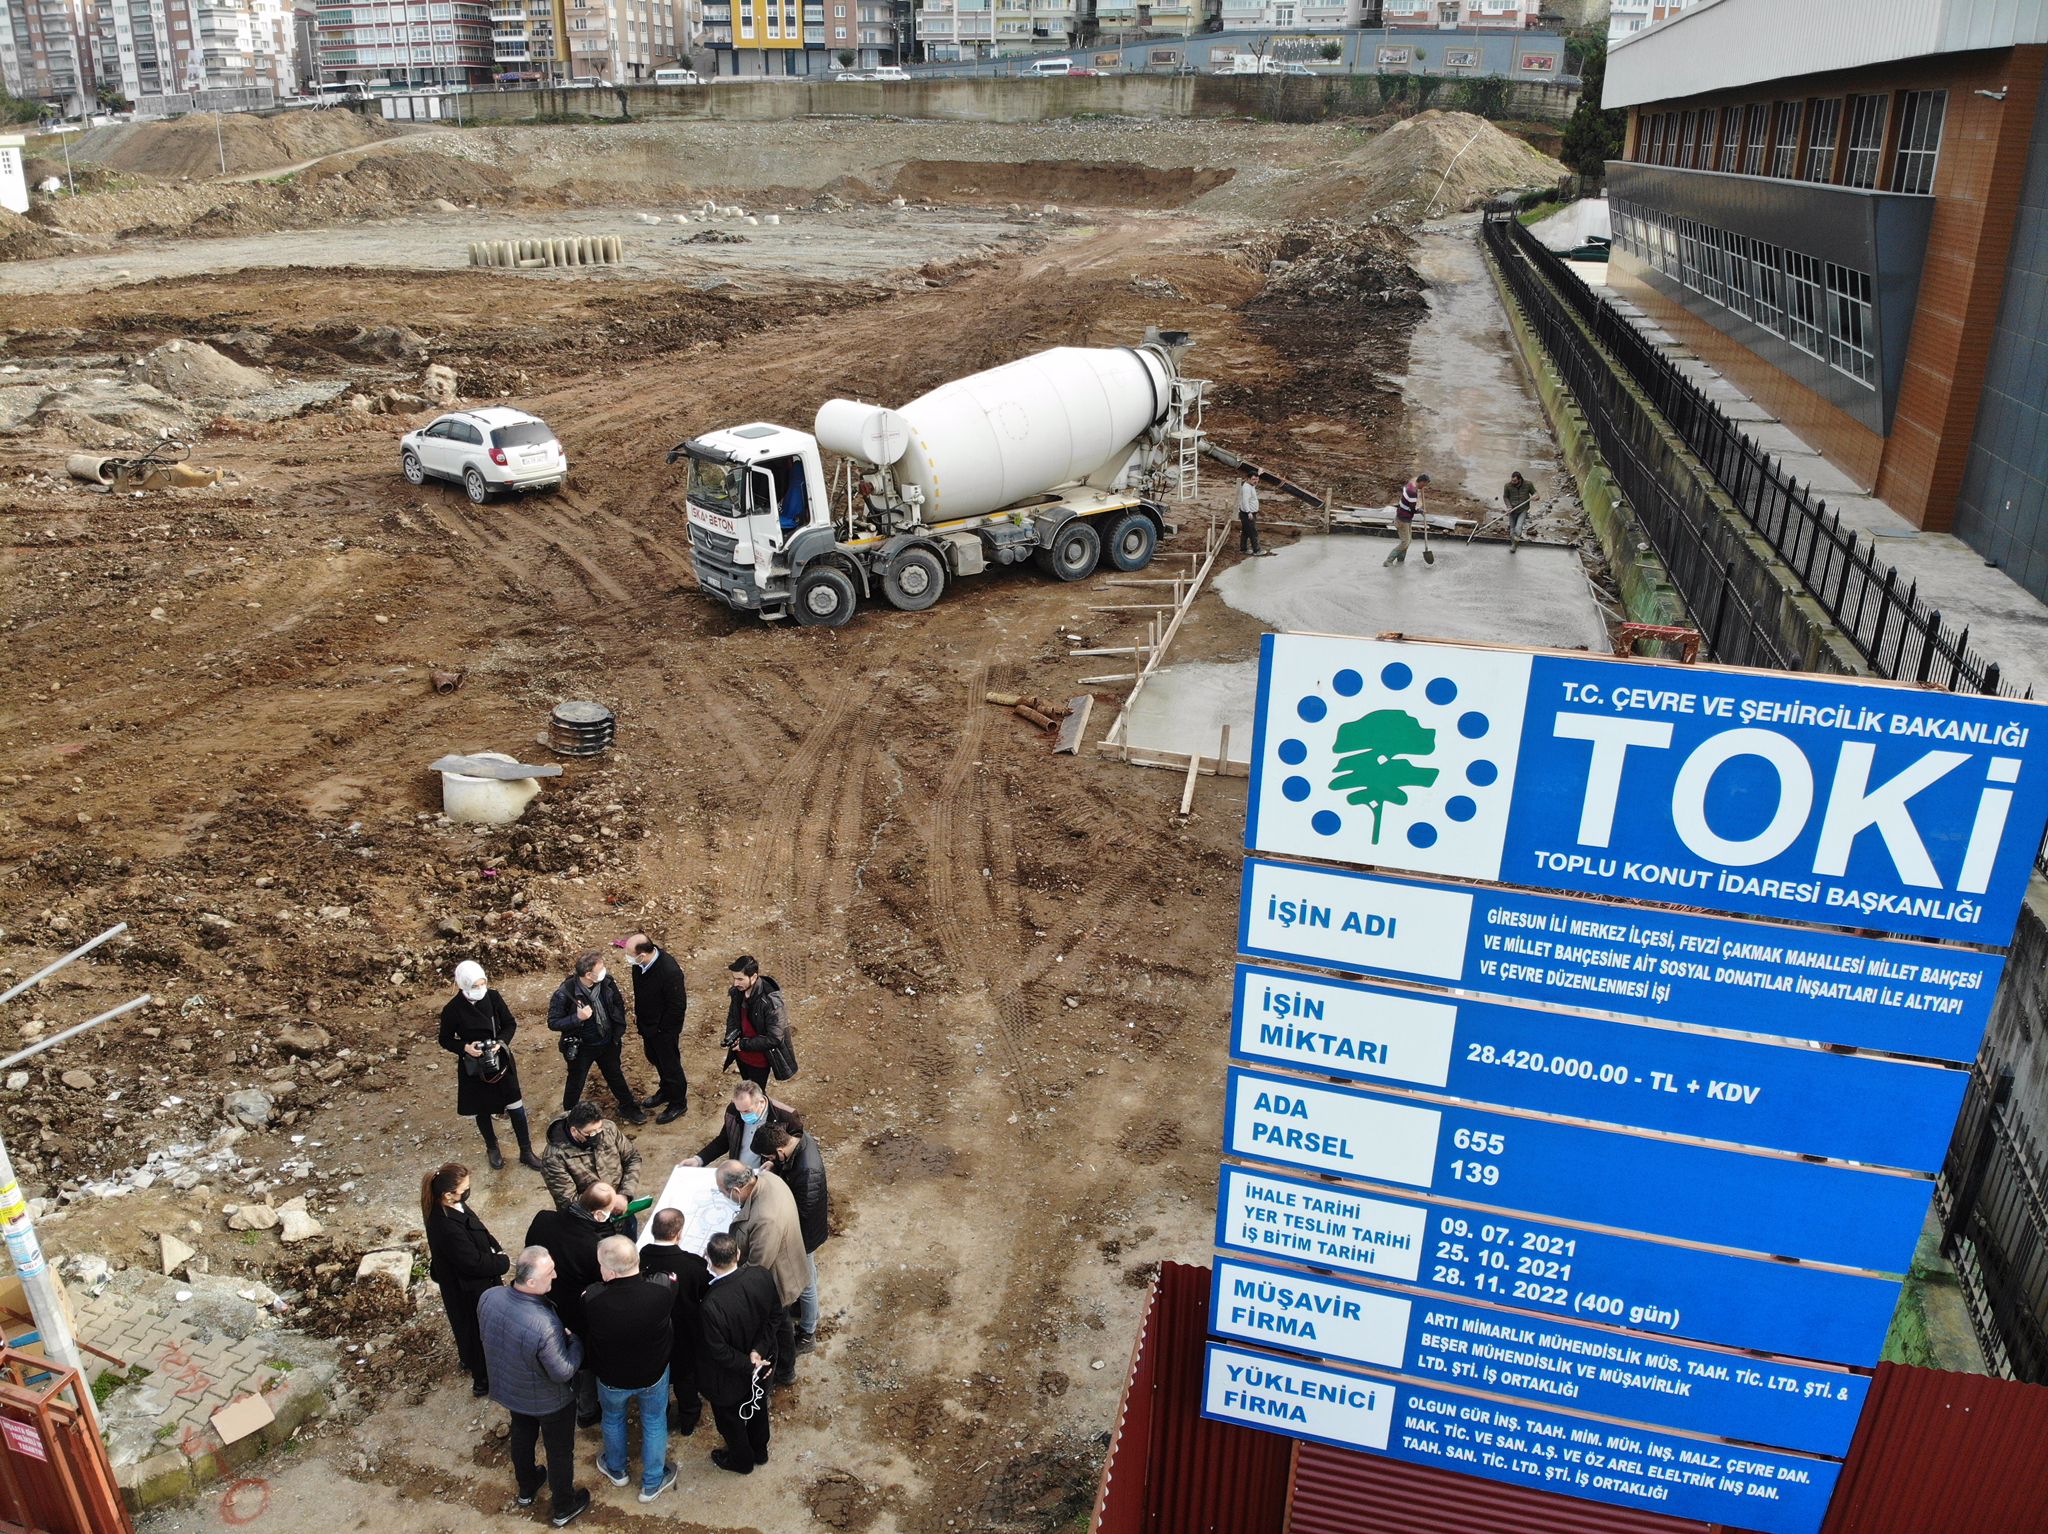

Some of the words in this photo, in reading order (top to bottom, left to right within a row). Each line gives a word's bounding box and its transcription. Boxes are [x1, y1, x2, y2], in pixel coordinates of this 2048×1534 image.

[1562, 682, 1604, 705] T.C.
[1611, 687, 1697, 714] ÇEVRE
[1702, 695, 1735, 718] VE
[1739, 699, 1886, 733] ŞEHİRCİLİK
[1889, 714, 2029, 748] BAKANLIĞI
[1552, 711, 2022, 896] TOKİ
[1534, 850, 1617, 877] TOPLU
[1623, 862, 1714, 889] KONUT
[1718, 869, 1821, 904] İDARESİ
[1825, 887, 1982, 924] BAŞKANLIĞI
[1268, 894, 1332, 929] İŞİN
[1340, 911, 1397, 939] ADI
[1487, 907, 1547, 930] GİRESUN
[1549, 914, 1568, 933] İLİ
[1569, 919, 1627, 942] MERKEZ
[1628, 924, 1676, 952] İLÇESİ,
[1679, 935, 1721, 955] FEVZİ
[1722, 941, 1784, 964] ÇAKMAK
[1784, 949, 1866, 974] MAHALLESİ
[1866, 958, 1919, 981] MİLLET
[1919, 967, 1983, 990] BAHÇESİ
[1480, 959, 1498, 976] VE
[1500, 962, 1544, 984] ÇEVRE
[1546, 969, 1650, 998] DÜZENLENMESİ
[1651, 981, 1671, 1004] İŞİ
[1484, 934, 1502, 951] VE
[1503, 935, 1553, 958] MİLLET
[1554, 944, 1632, 970] BAHÇESİNE
[1632, 953, 1658, 973] AİT
[1659, 959, 1712, 981] SOSYAL
[1714, 967, 1794, 992] DONATILAR
[1795, 975, 1879, 1004] İNŞAATLARI
[1879, 986, 1904, 1007] İLE
[1904, 993, 1964, 1015] ALTYAPI
[1263, 986, 1325, 1021] İŞİN
[1259, 1023, 1388, 1065] MİKTARI
[1466, 1043, 1628, 1085] 28.420.000.00
[1650, 1071, 1678, 1093] TL
[1687, 1079, 1700, 1093] +
[1707, 1080, 1761, 1105] KDV
[1253, 1092, 1309, 1120] ADA
[1252, 1122, 1354, 1160] PARSEL
[1454, 1128, 1505, 1155] 655
[1451, 1159, 1500, 1186] 139
[1245, 1181, 1297, 1207] İHALE
[1302, 1196, 1361, 1220] TARİHİ
[1242, 1225, 1258, 1244] İŞ
[1263, 1230, 1312, 1252] BİTİM
[1317, 1241, 1376, 1265] TARİHİ
[1244, 1205, 1278, 1225] YER
[1283, 1213, 1347, 1238] TESLİM
[1352, 1226, 1411, 1251] TARİHİ
[1441, 1217, 1474, 1239] 09.
[1481, 1225, 1514, 1247] 07.
[1521, 1232, 1576, 1257] 2021
[1436, 1241, 1469, 1263] 25.
[1478, 1249, 1510, 1271] 10.
[1517, 1256, 1571, 1282] 2021
[1233, 1279, 1361, 1321] MÜŞAVİR
[1432, 1265, 1465, 1287] 28.
[1474, 1273, 1506, 1295] 11.
[1512, 1280, 1568, 1306] 2022
[1574, 1292, 1624, 1316] (400
[1629, 1305, 1680, 1330] gün)
[1231, 1306, 1317, 1341] FİRMA
[1418, 1354, 1448, 1372] LTD.
[1451, 1361, 1478, 1378] ŞTİ.
[1483, 1365, 1498, 1385] İŞ
[1501, 1371, 1579, 1398] ORTAKLIĞI
[1421, 1333, 1469, 1354] BEŞER
[1471, 1343, 1573, 1375] MÜHENDİSLİK
[1577, 1363, 1597, 1379] VE
[1599, 1368, 1692, 1397] MÜŞAVİRLİK
[1424, 1312, 1459, 1330] ARTI
[1461, 1318, 1536, 1345] MİMARLIK
[1538, 1334, 1642, 1365] MÜHENDİSLİK
[1645, 1354, 1682, 1373] MÜS.
[1687, 1361, 1730, 1381] TAAH.
[1736, 1369, 1763, 1387] TİC.
[1768, 1375, 1800, 1393] LTD.
[1804, 1382, 1832, 1399] ŞTİ.
[1836, 1387, 1848, 1401] &
[1223, 1389, 1307, 1424] FİRMA
[1226, 1364, 1376, 1411] YÜKLENİCİ
[1405, 1416, 1439, 1434] MAK.
[1444, 1423, 1470, 1441] TİC.
[1475, 1431, 1493, 1445] VE
[1496, 1435, 1528, 1453] SAN.
[1531, 1443, 1558, 1460] A.Ş.
[1563, 1448, 1582, 1463] VE
[1584, 1451, 1605, 1468] ÖZ
[1606, 1458, 1644, 1476] AREL
[1647, 1465, 1716, 1489] ELELTRİK
[1718, 1478, 1744, 1496] İNŞ
[1746, 1483, 1779, 1500] DAN.
[1408, 1397, 1457, 1417] OLGUN
[1460, 1407, 1491, 1424] GÜR
[1493, 1414, 1521, 1432] İNŞ.
[1526, 1420, 1566, 1440] TAAH.
[1570, 1429, 1602, 1447] MİM.
[1606, 1436, 1643, 1455] MÜH.
[1647, 1444, 1675, 1462] İNŞ.
[1679, 1450, 1722, 1469] MALZ.
[1726, 1459, 1775, 1478] ÇEVRE
[1776, 1467, 1810, 1484] DAN.
[1402, 1436, 1442, 1455] TAAH.
[1445, 1445, 1477, 1463] SAN.
[1482, 1452, 1508, 1469] TİC.
[1512, 1459, 1541, 1476] LTD.
[1545, 1466, 1571, 1482] ŞTİ.
[1575, 1469, 1590, 1488] İŞ
[1592, 1475, 1668, 1500] ORTAKLIĞI
